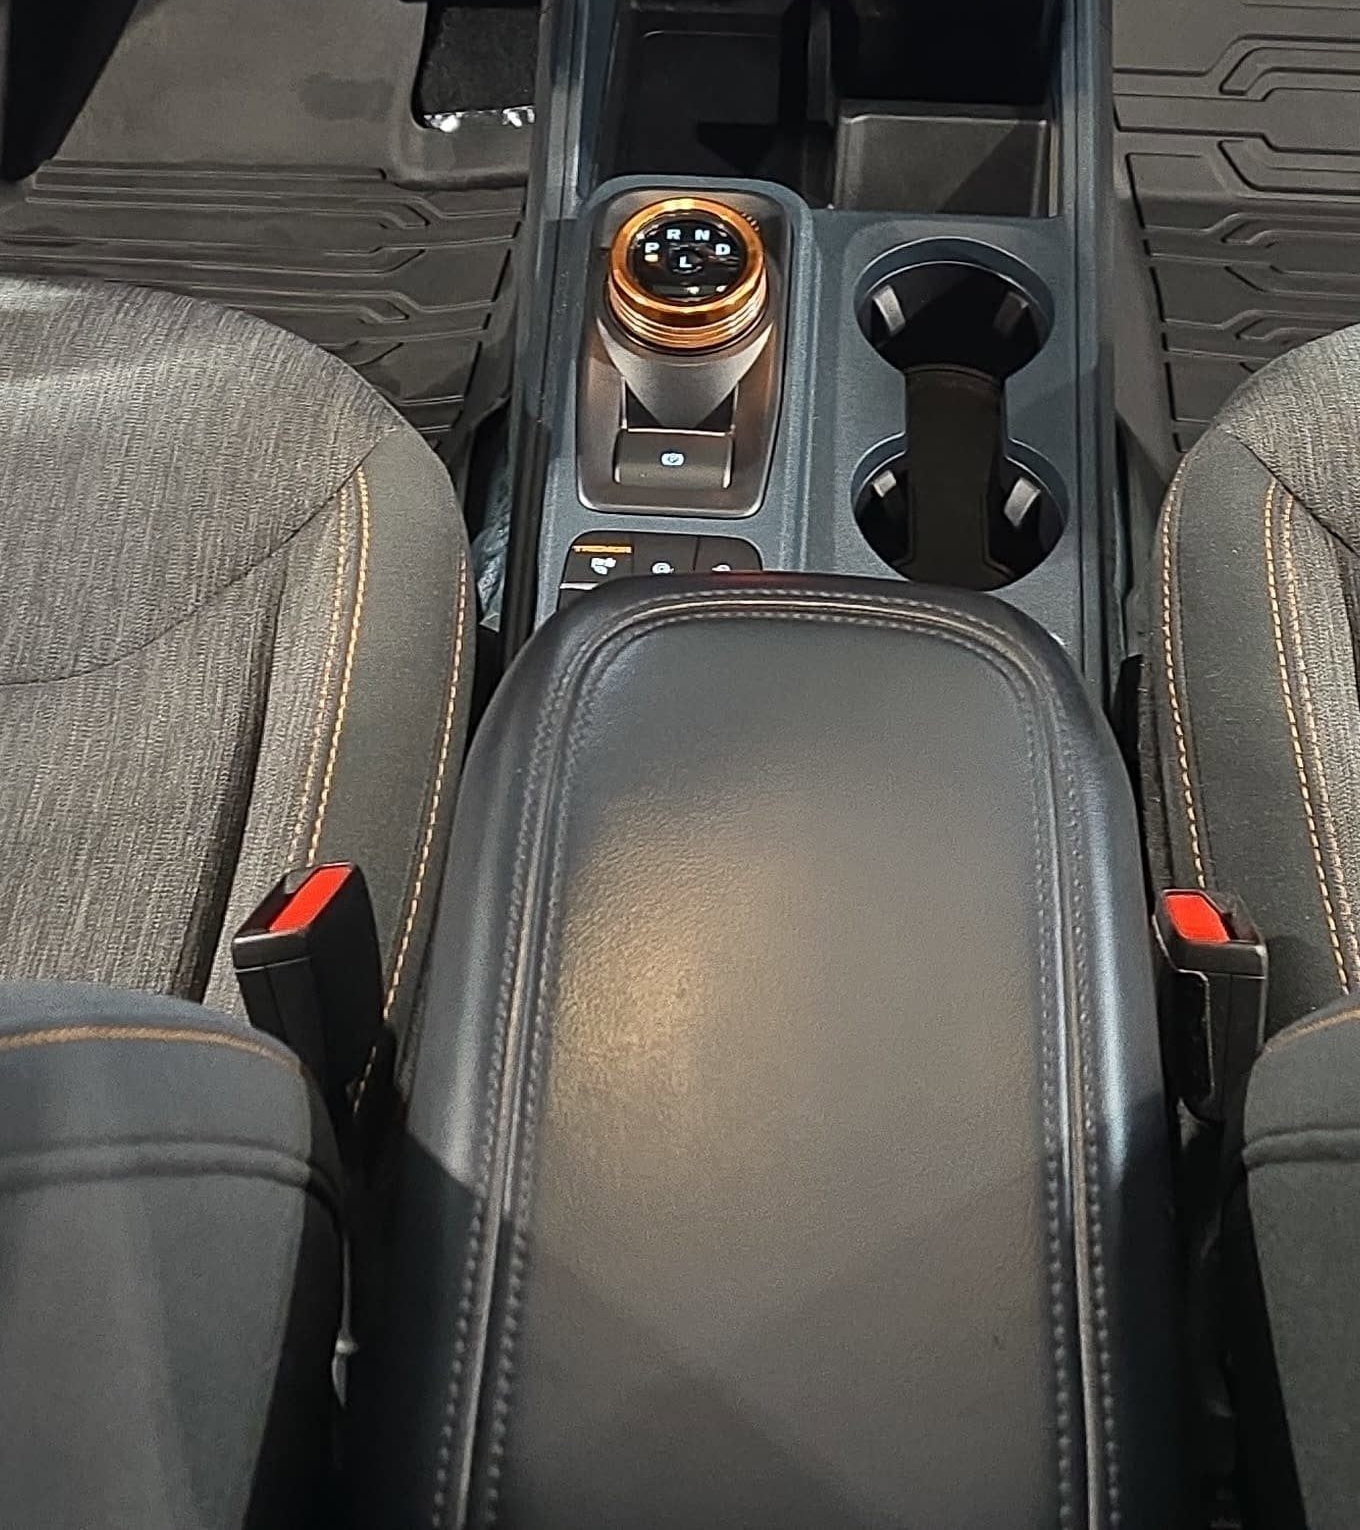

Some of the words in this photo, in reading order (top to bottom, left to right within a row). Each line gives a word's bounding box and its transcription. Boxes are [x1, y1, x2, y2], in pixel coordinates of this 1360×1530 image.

[666, 229, 682, 240] R
[695, 229, 711, 241] N
[645, 242, 660, 253] P
[715, 244, 731, 255] D
[680, 256, 693, 268] L
